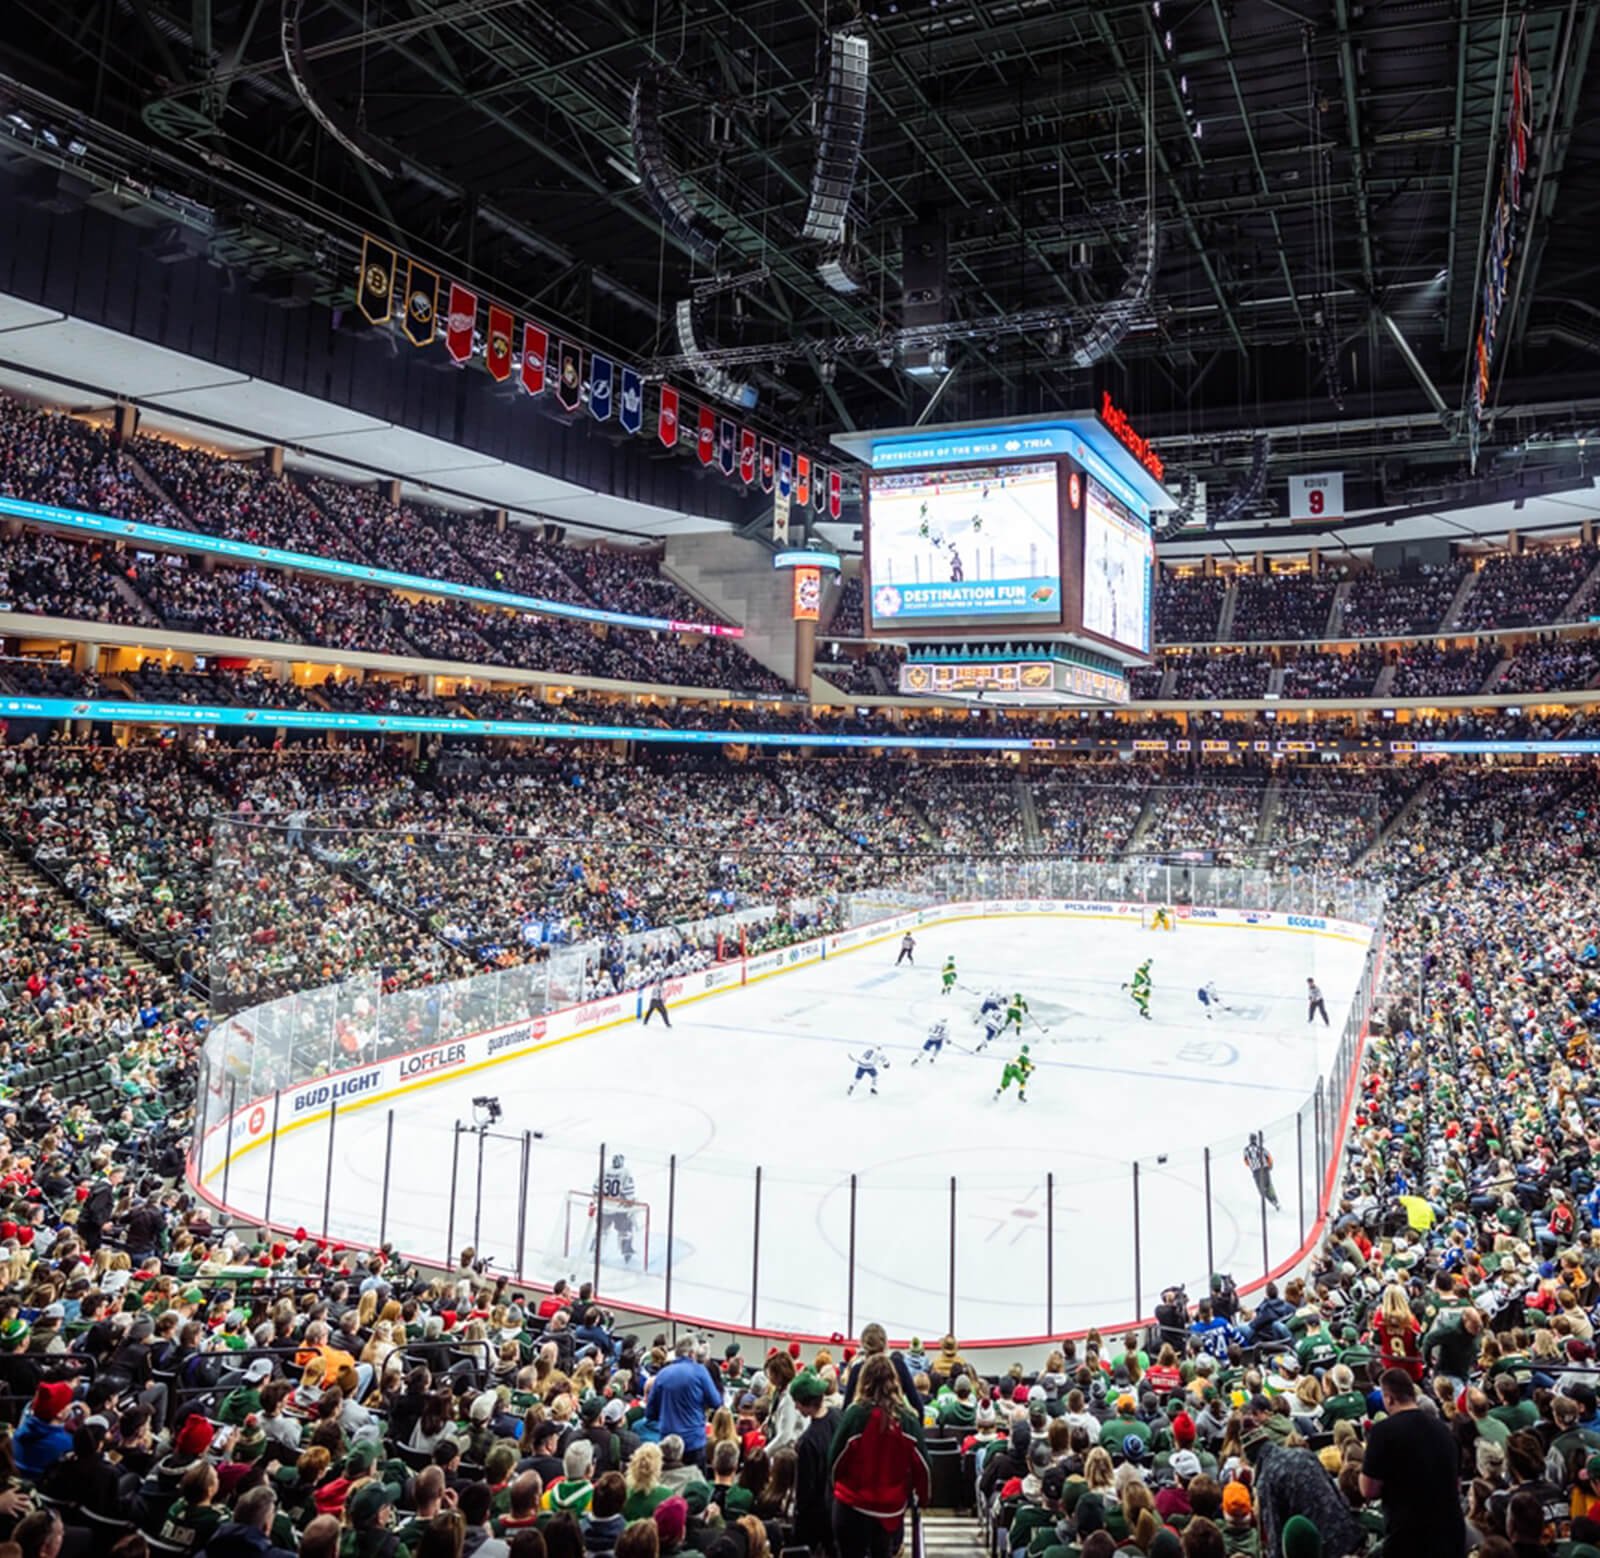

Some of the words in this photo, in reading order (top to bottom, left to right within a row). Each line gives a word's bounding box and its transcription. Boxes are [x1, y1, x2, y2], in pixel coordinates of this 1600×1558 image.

[880, 450, 934, 462] PHYSICIANS
[937, 448, 949, 457] OF
[953, 446, 970, 455] THE
[973, 444, 997, 453] WILD
[1024, 438, 1052, 448] TRIA
[1309, 489, 1324, 514] 9
[904, 588, 995, 602] DESTINATION
[998, 586, 1025, 598] FUN
[1063, 903, 1113, 913] POLARIS
[1192, 909, 1217, 919] bank
[1287, 916, 1326, 929] ECOLAB
[487, 1024, 531, 1055] guaranteed
[400, 1044, 465, 1077] LOFFLER
[294, 1086, 330, 1112] BUD
[331, 1071, 381, 1099] LIGHT
[603, 1179, 620, 1197] 30
